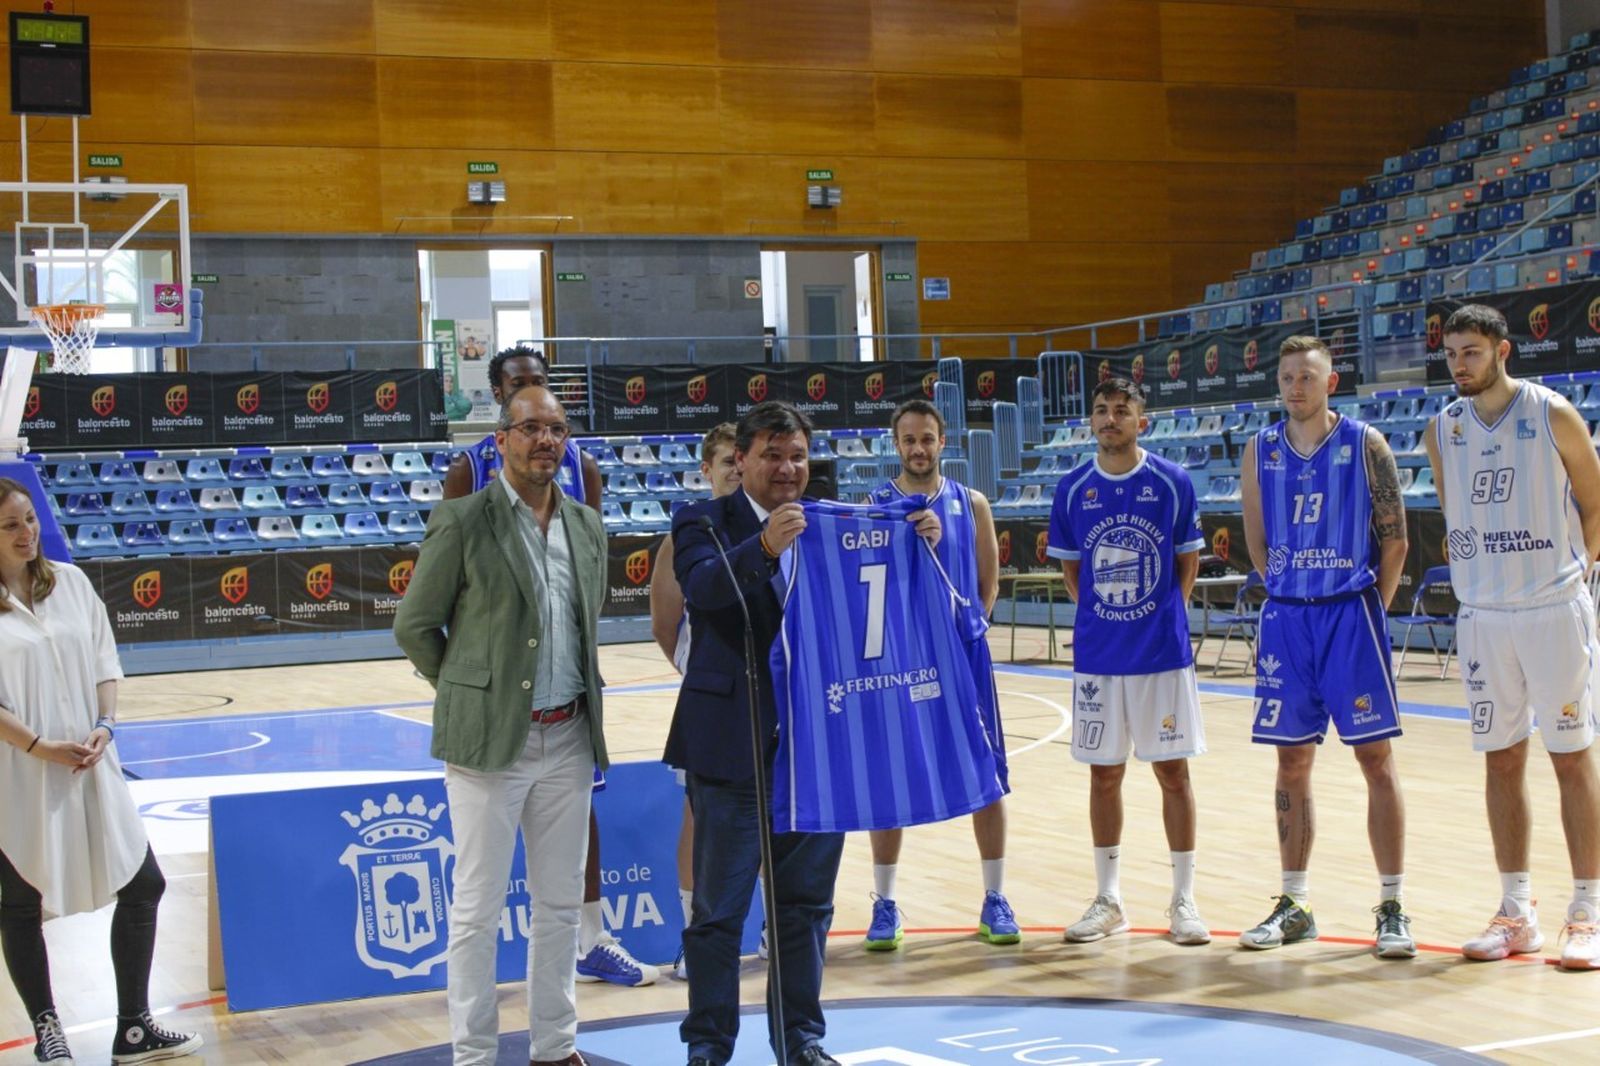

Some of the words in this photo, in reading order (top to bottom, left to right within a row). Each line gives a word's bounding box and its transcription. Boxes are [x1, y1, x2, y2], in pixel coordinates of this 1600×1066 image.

[90, 156, 120, 166] SALIDA
[470, 163, 496, 172] SALIDA
[808, 171, 832, 179] SALIDA
[614, 404, 659, 416] baloncesto
[676, 403, 719, 414] baloncesto
[855, 401, 897, 411] baloncesto
[78, 416, 131, 429] baloncesto
[152, 416, 204, 427] baloncesto
[224, 414, 275, 426] baloncesto
[294, 413, 344, 425] baloncesto
[363, 411, 411, 423] baloncesto
[1471, 467, 1515, 505] 99
[1292, 492, 1324, 525] 13
[1084, 516, 1114, 550] CIUDAD
[1116, 513, 1128, 525] DE
[1130, 515, 1166, 545] HUELVA
[1483, 529, 1532, 542] HUELVA
[841, 530, 890, 550] GABI
[1484, 542, 1498, 554] TE
[1500, 538, 1554, 553] SALUDA
[1293, 548, 1337, 560] HUELVA
[1292, 559, 1305, 569] TE
[1306, 558, 1354, 569] SALUDA
[611, 584, 652, 597] balonce
[291, 600, 350, 614] baloncesto
[374, 598, 401, 609] balon
[117, 607, 179, 623] baloncesto
[205, 603, 266, 618] baloncesto
[859, 563, 888, 660] 1
[846, 665, 938, 694] FERTINAGRO
[1253, 696, 1283, 728] 13
[1471, 700, 1494, 734] 9
[1078, 719, 1105, 750] 10
[376, 855, 388, 864] ET
[626, 863, 651, 882] de
[361, 872, 371, 902] MARIS
[431, 877, 444, 923] CUSTODIA
[364, 905, 375, 942] PORTUS
